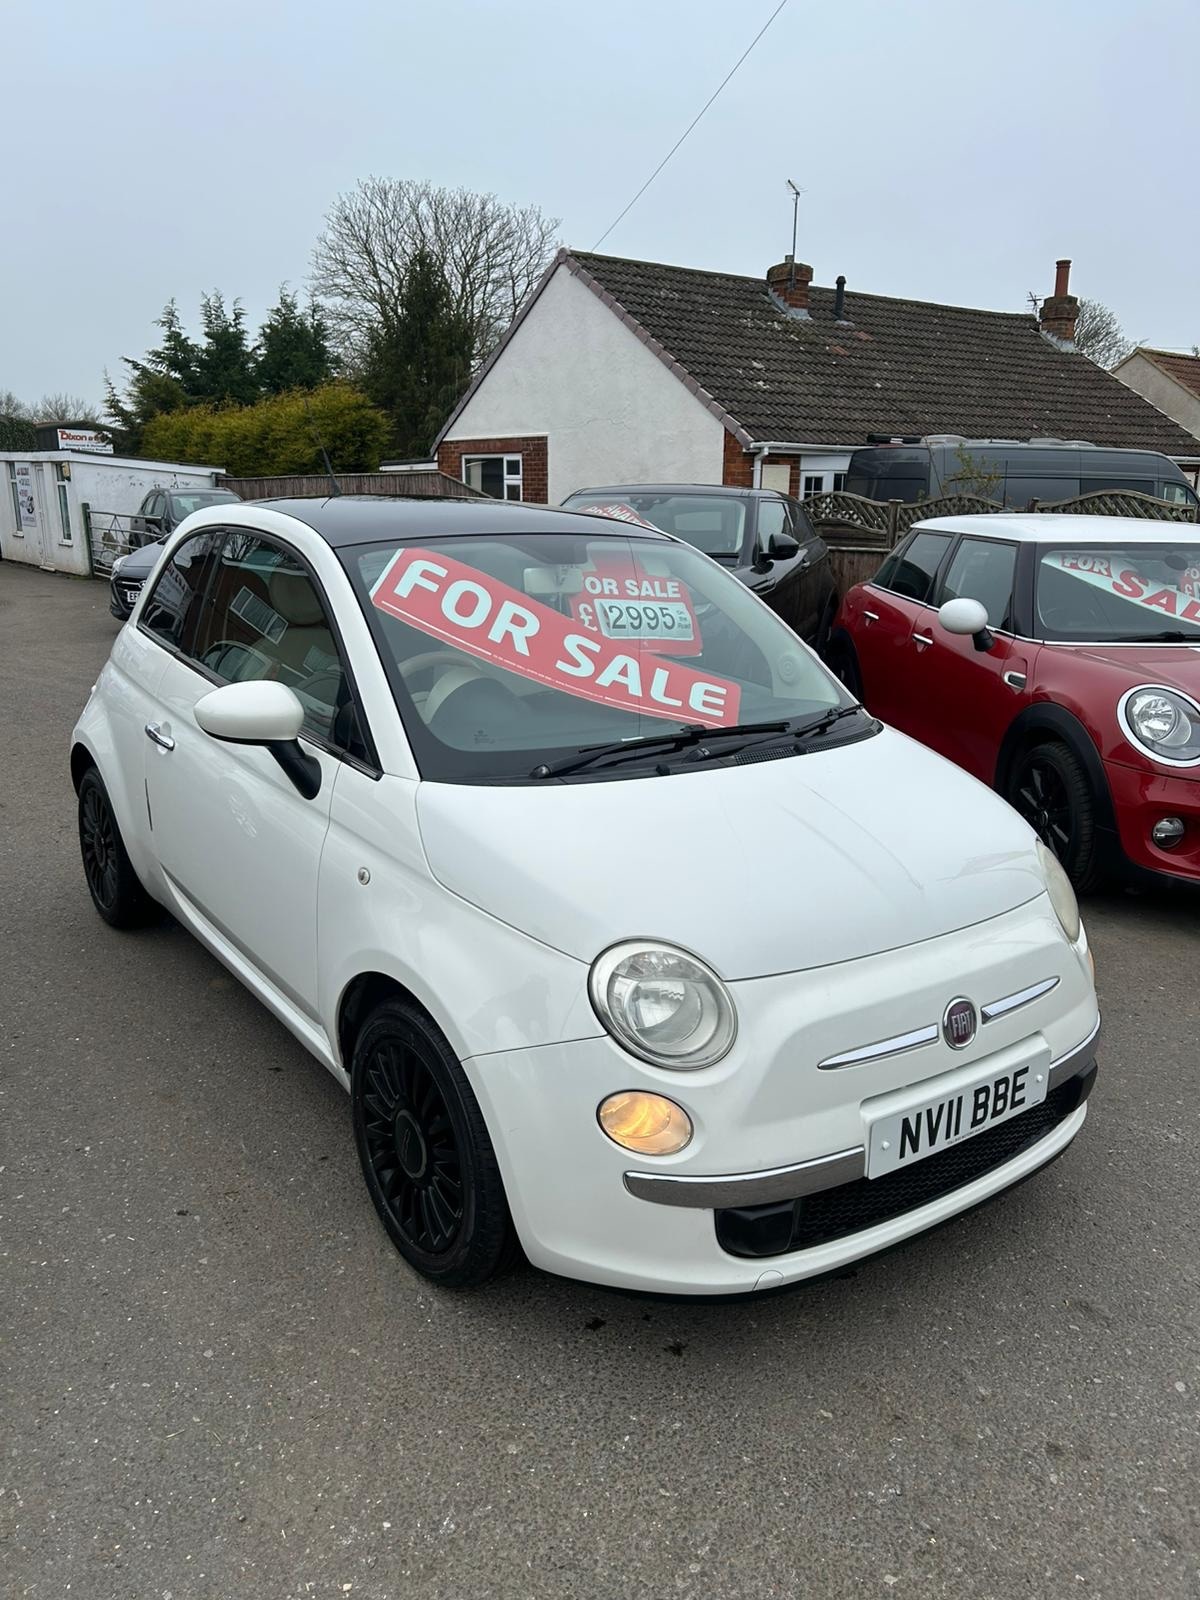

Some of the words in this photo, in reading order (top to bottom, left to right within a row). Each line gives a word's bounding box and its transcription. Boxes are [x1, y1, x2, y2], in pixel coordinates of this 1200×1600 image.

[1063, 553, 1109, 576] FOR
[584, 576, 619, 595] OR
[624, 579, 681, 598] SALE
[394, 559, 541, 656] FOR
[555, 633, 727, 718] SALE
[951, 1010, 970, 1038] FIAT
[899, 1095, 963, 1159] NV11
[971, 1066, 1029, 1128] BBE
